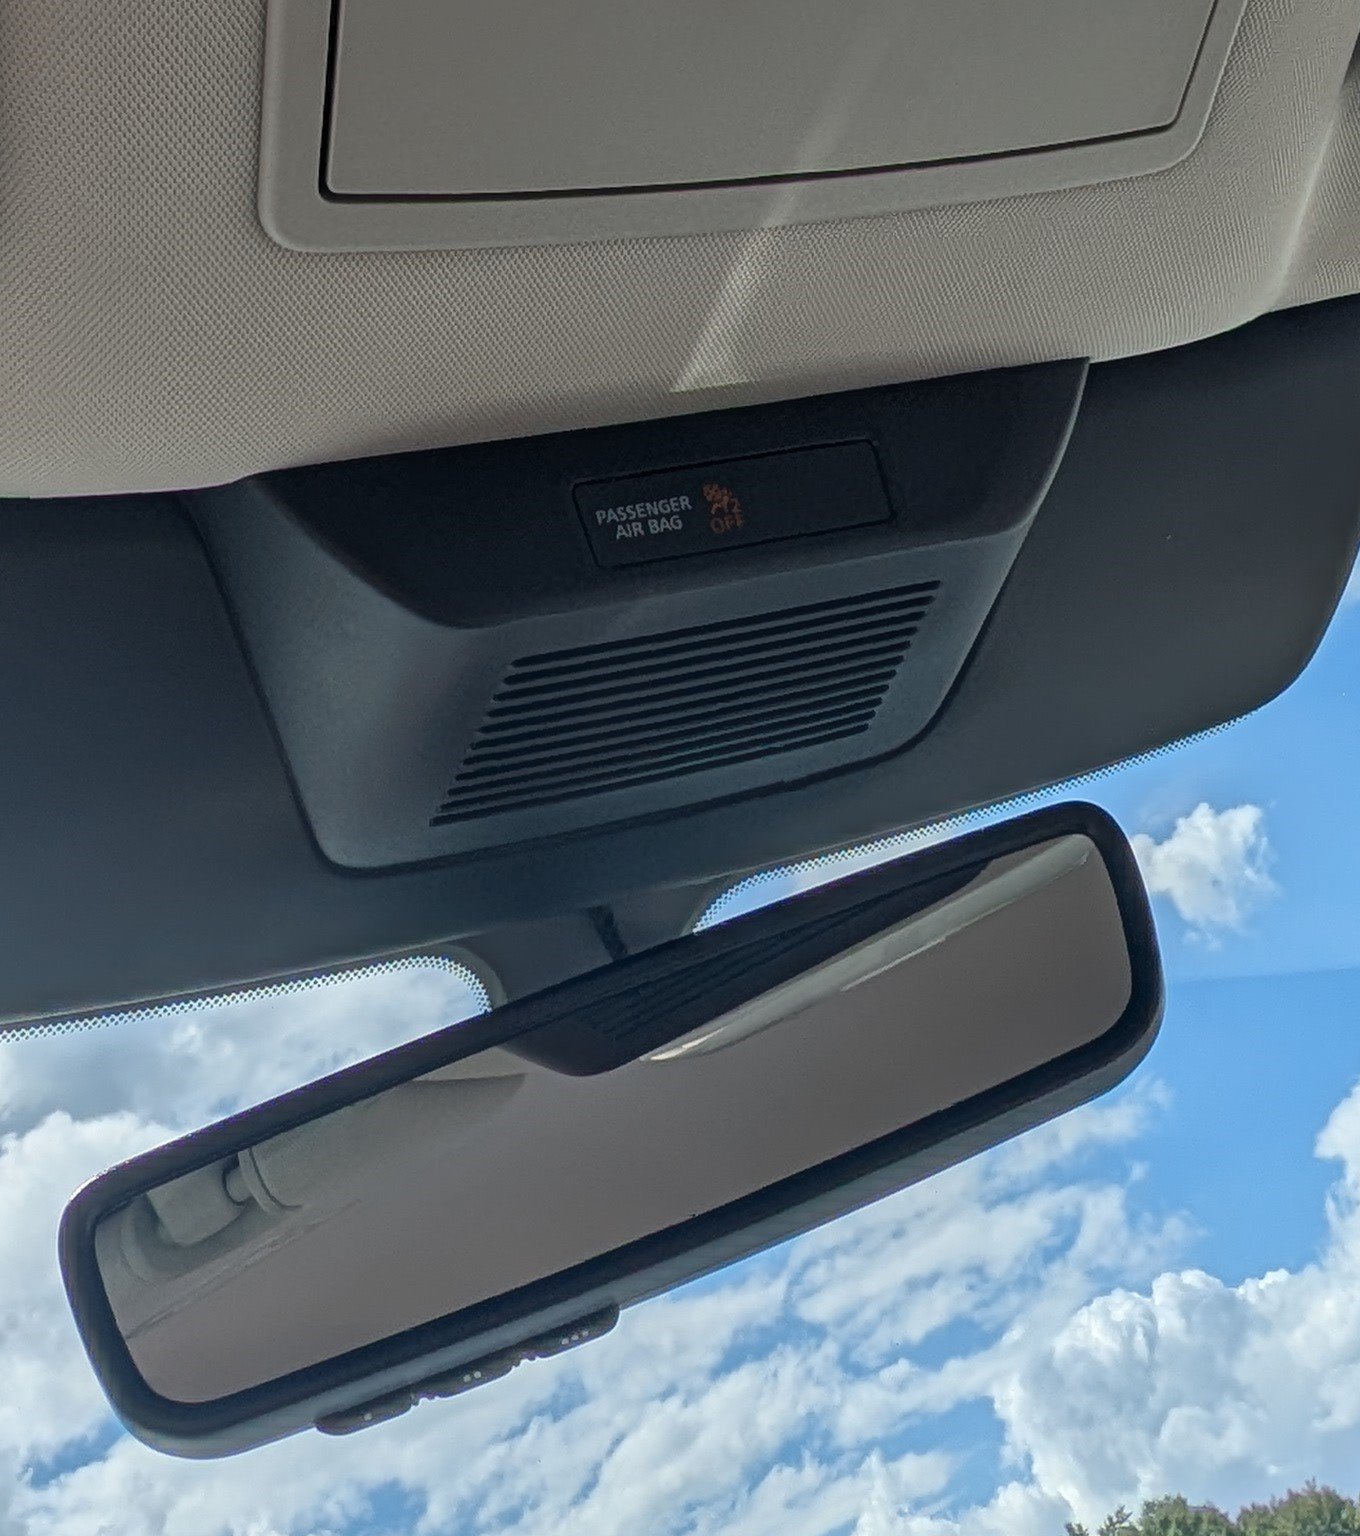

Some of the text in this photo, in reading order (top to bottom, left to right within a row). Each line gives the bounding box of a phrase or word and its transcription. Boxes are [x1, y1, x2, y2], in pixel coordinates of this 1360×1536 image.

[595, 495, 693, 524] PASSENGER
[615, 514, 683, 540] AIR BAG
